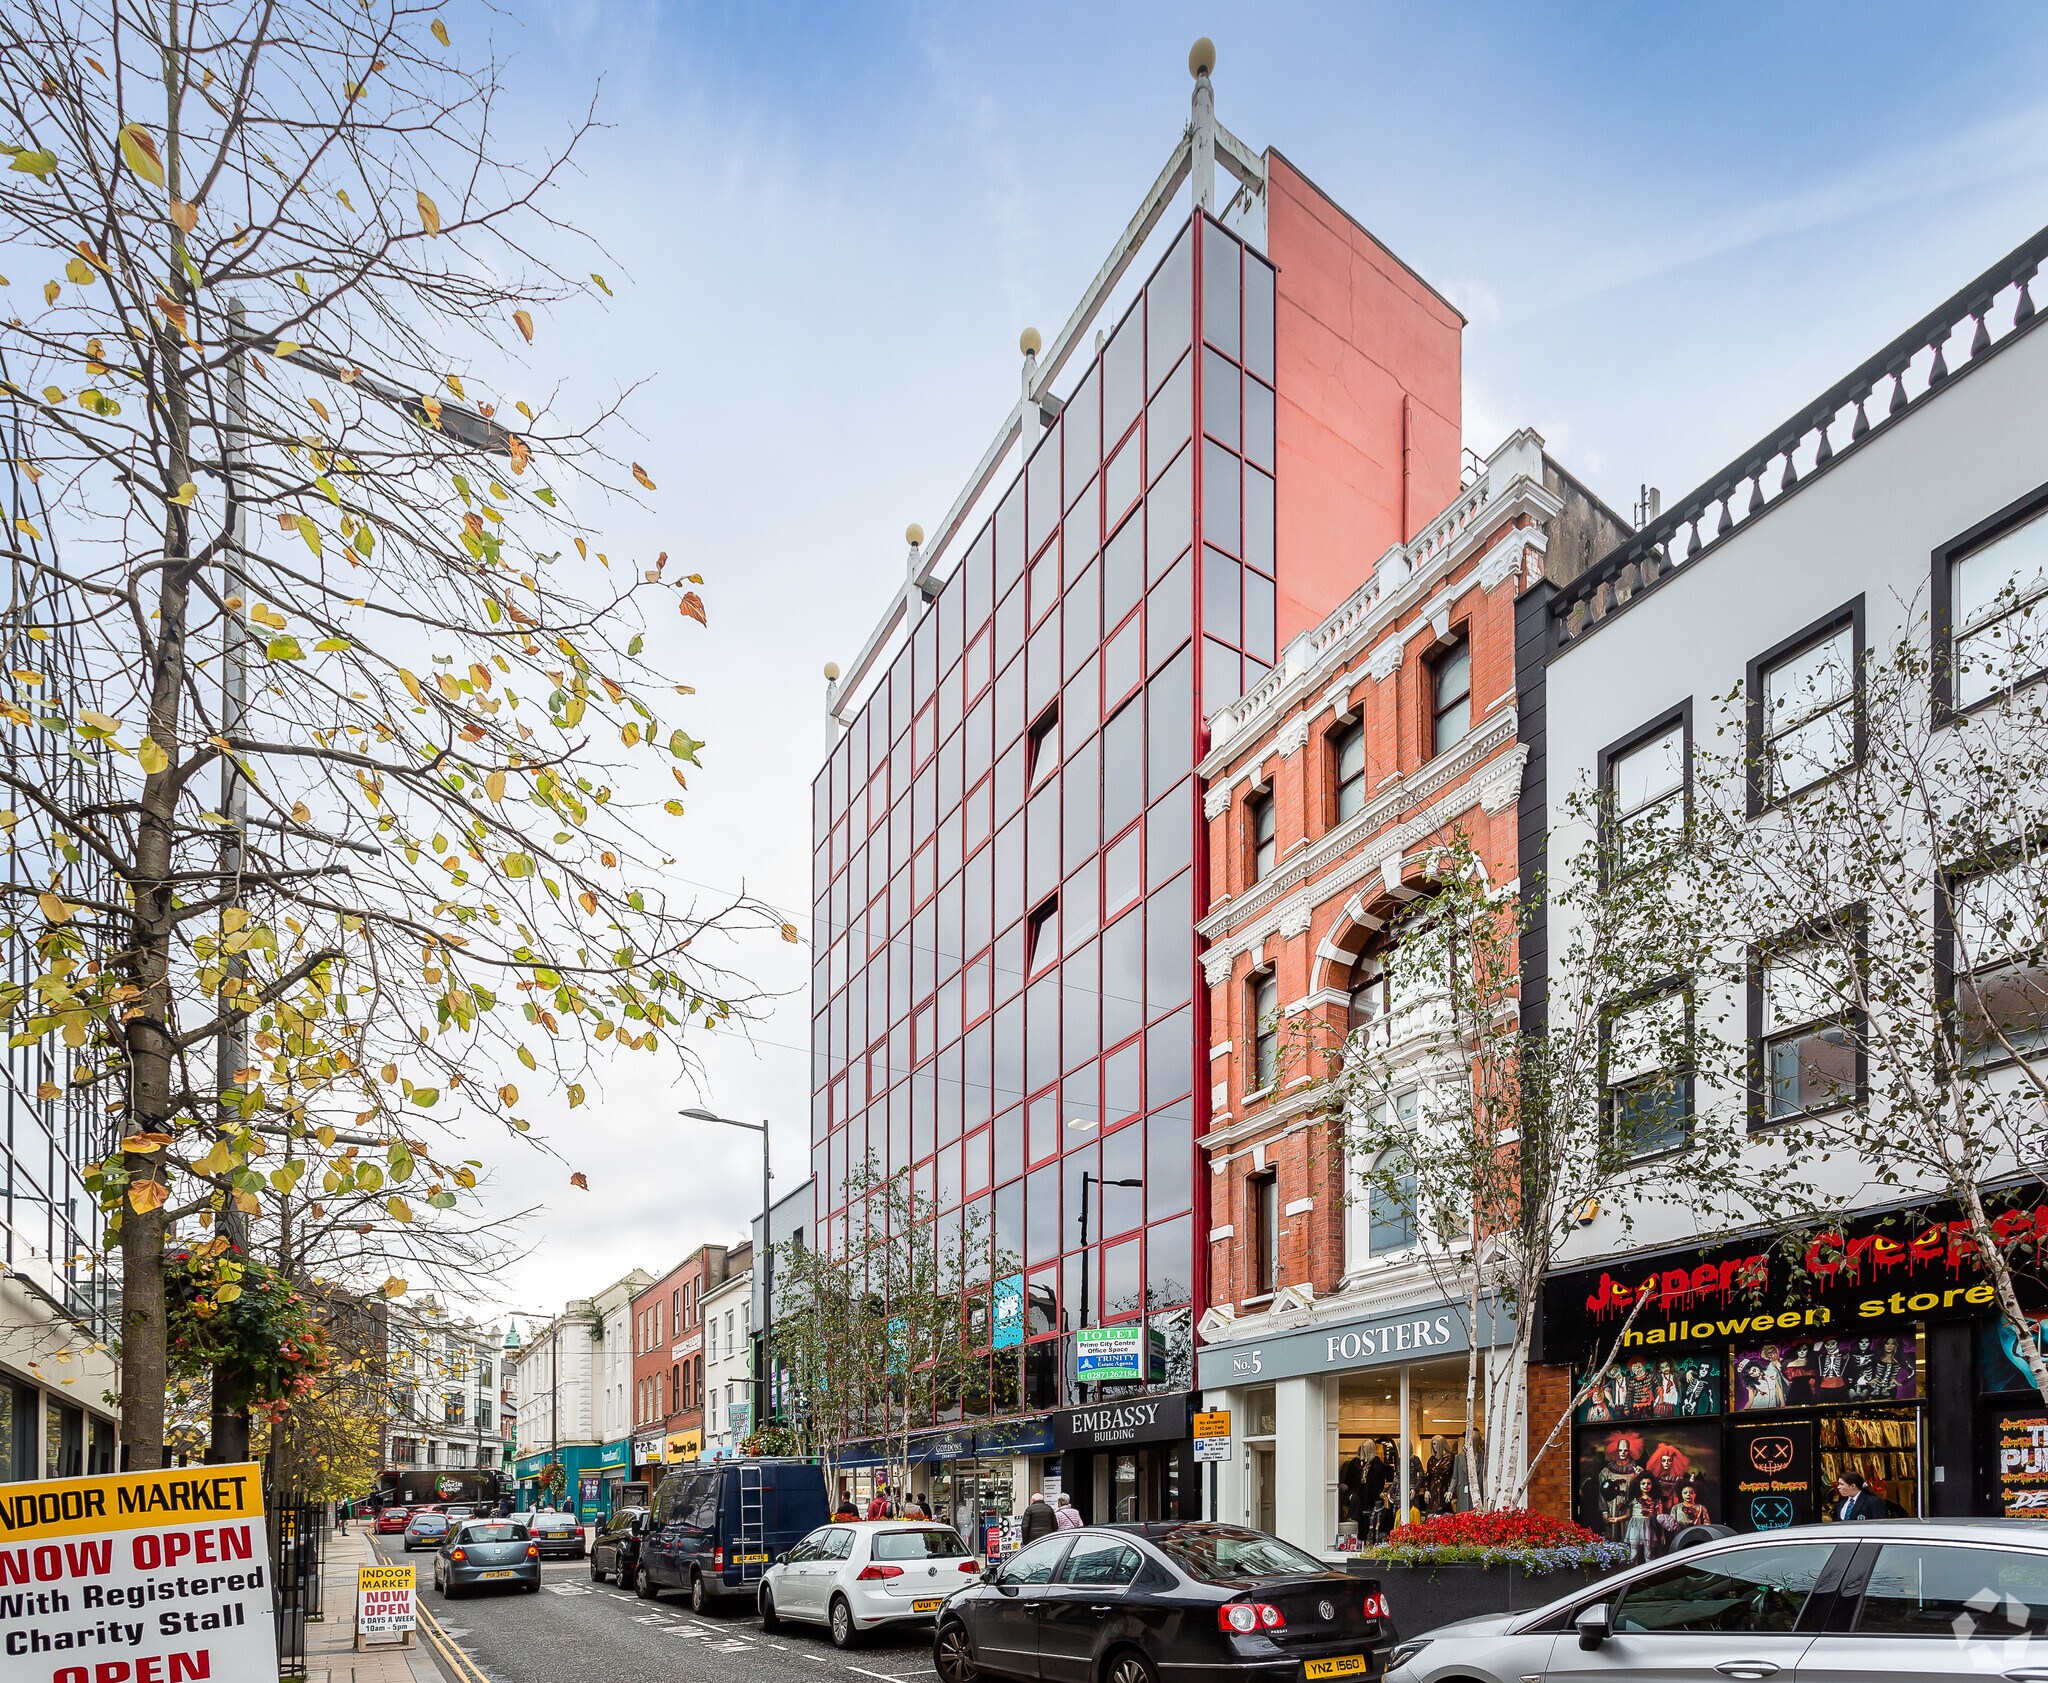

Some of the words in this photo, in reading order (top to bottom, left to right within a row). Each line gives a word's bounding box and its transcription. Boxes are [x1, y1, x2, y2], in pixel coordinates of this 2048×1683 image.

[1806, 1205, 2048, 1291] Creepe
[1624, 1307, 1831, 1347] halloween
[1858, 1285, 1995, 1318] store
[1080, 1331, 1100, 1340] TO
[1106, 1329, 1135, 1339] LET
[1326, 1315, 1451, 1362] FOSTERS
[1096, 1354, 1135, 1362] TRINITY
[1072, 1403, 1160, 1434] EMBASSY
[1094, 1428, 1135, 1442] BUILDING
[935, 1442, 962, 1454] GORDONS
[1197, 1441, 1203, 1450] P
[0, 1489, 107, 1531] NDOOR
[117, 1476, 247, 1514] MARKET
[0, 1539, 113, 1586] NOW
[132, 1525, 253, 1571] OPEN
[362, 1569, 411, 1578] INDOOR
[361, 1579, 410, 1588] MARKET
[0, 1588, 70, 1619] With
[83, 1565, 265, 1610] Registered
[366, 1590, 409, 1603] NOW
[364, 1603, 410, 1616] OPEN
[367, 1616, 386, 1624] DAYS
[6, 1621, 144, 1656] Charity
[159, 1602, 245, 1636] Stall
[53, 1649, 211, 1683] OPEN
[1310, 1661, 1334, 1675] YNZ
[1336, 1659, 1360, 1672] 1560
